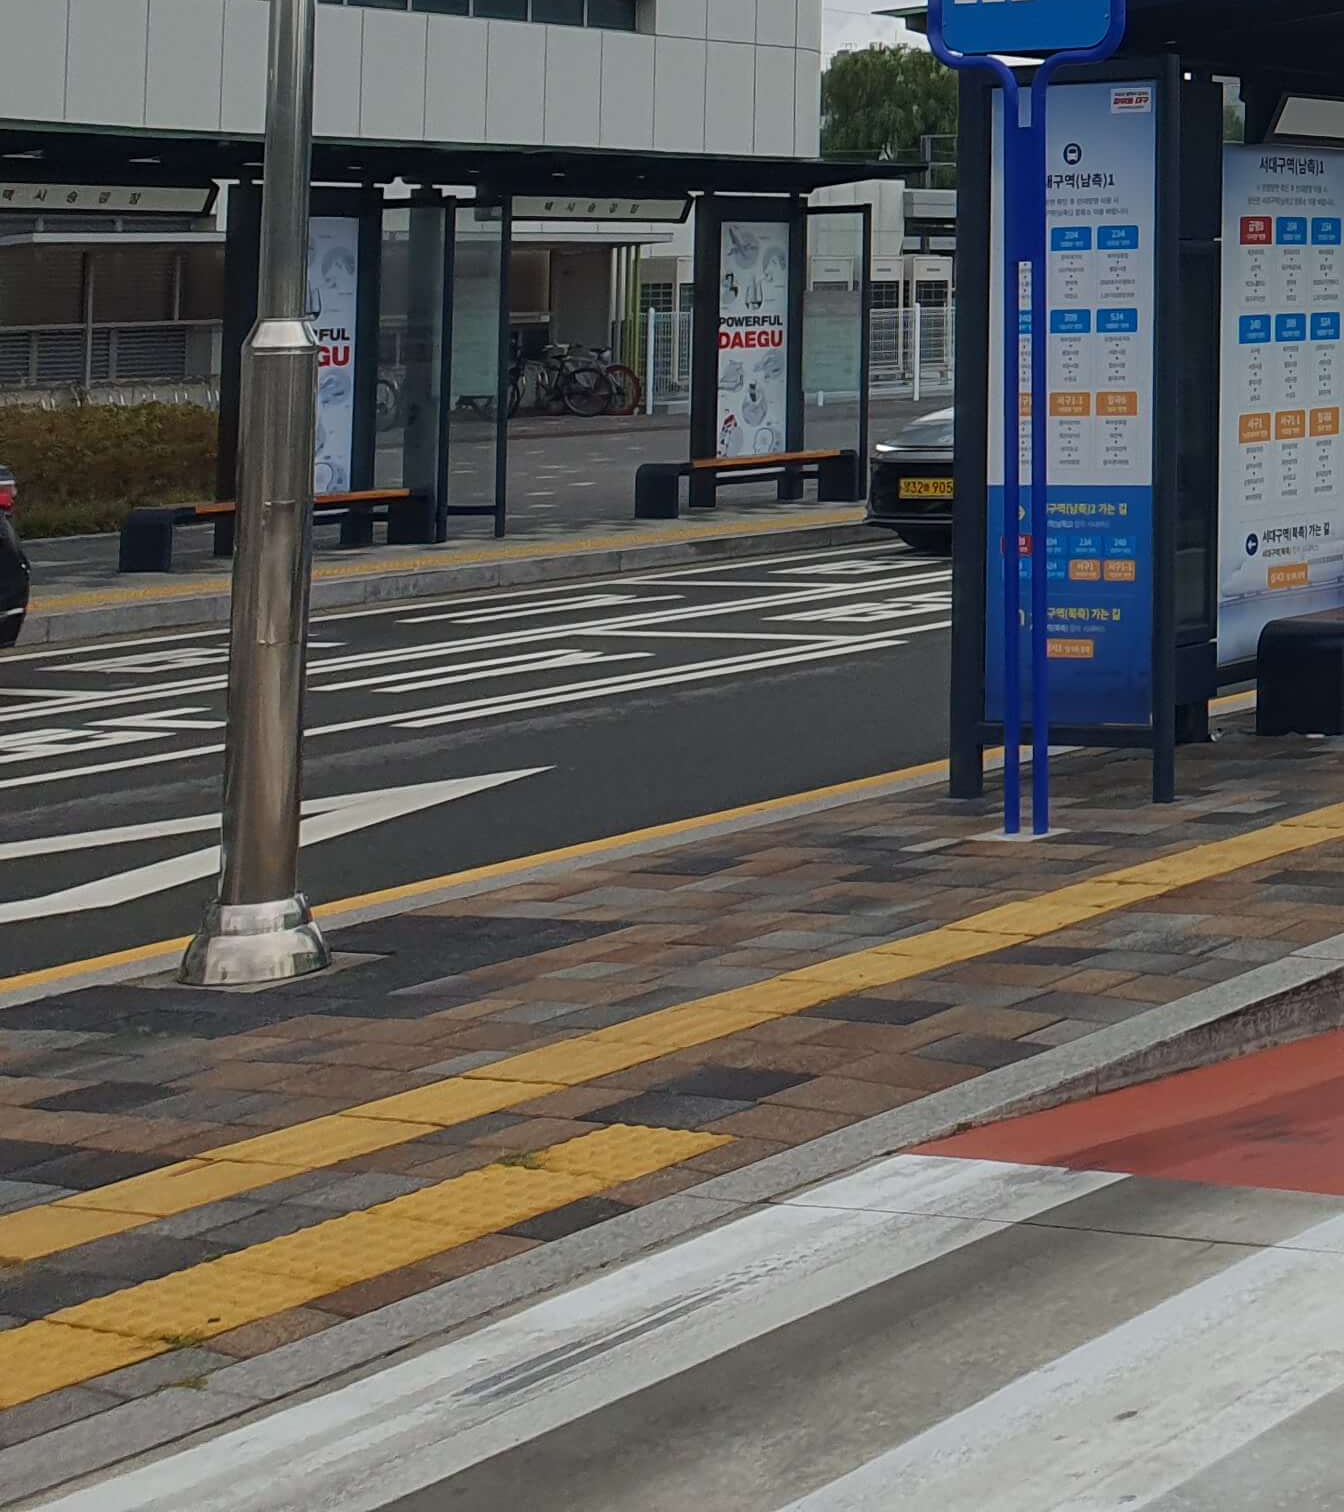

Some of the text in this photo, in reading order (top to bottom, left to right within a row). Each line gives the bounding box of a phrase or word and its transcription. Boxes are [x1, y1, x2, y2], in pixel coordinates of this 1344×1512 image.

[1259, 155, 1324, 176] 서대구역(남측)1
[1047, 173, 1115, 188] 구역(남측)1
[719, 315, 783, 327] POWERFUL
[718, 330, 783, 349] DAEGU
[1309, 523, 1323, 537] 가는
[1323, 522, 1330, 536] 길
